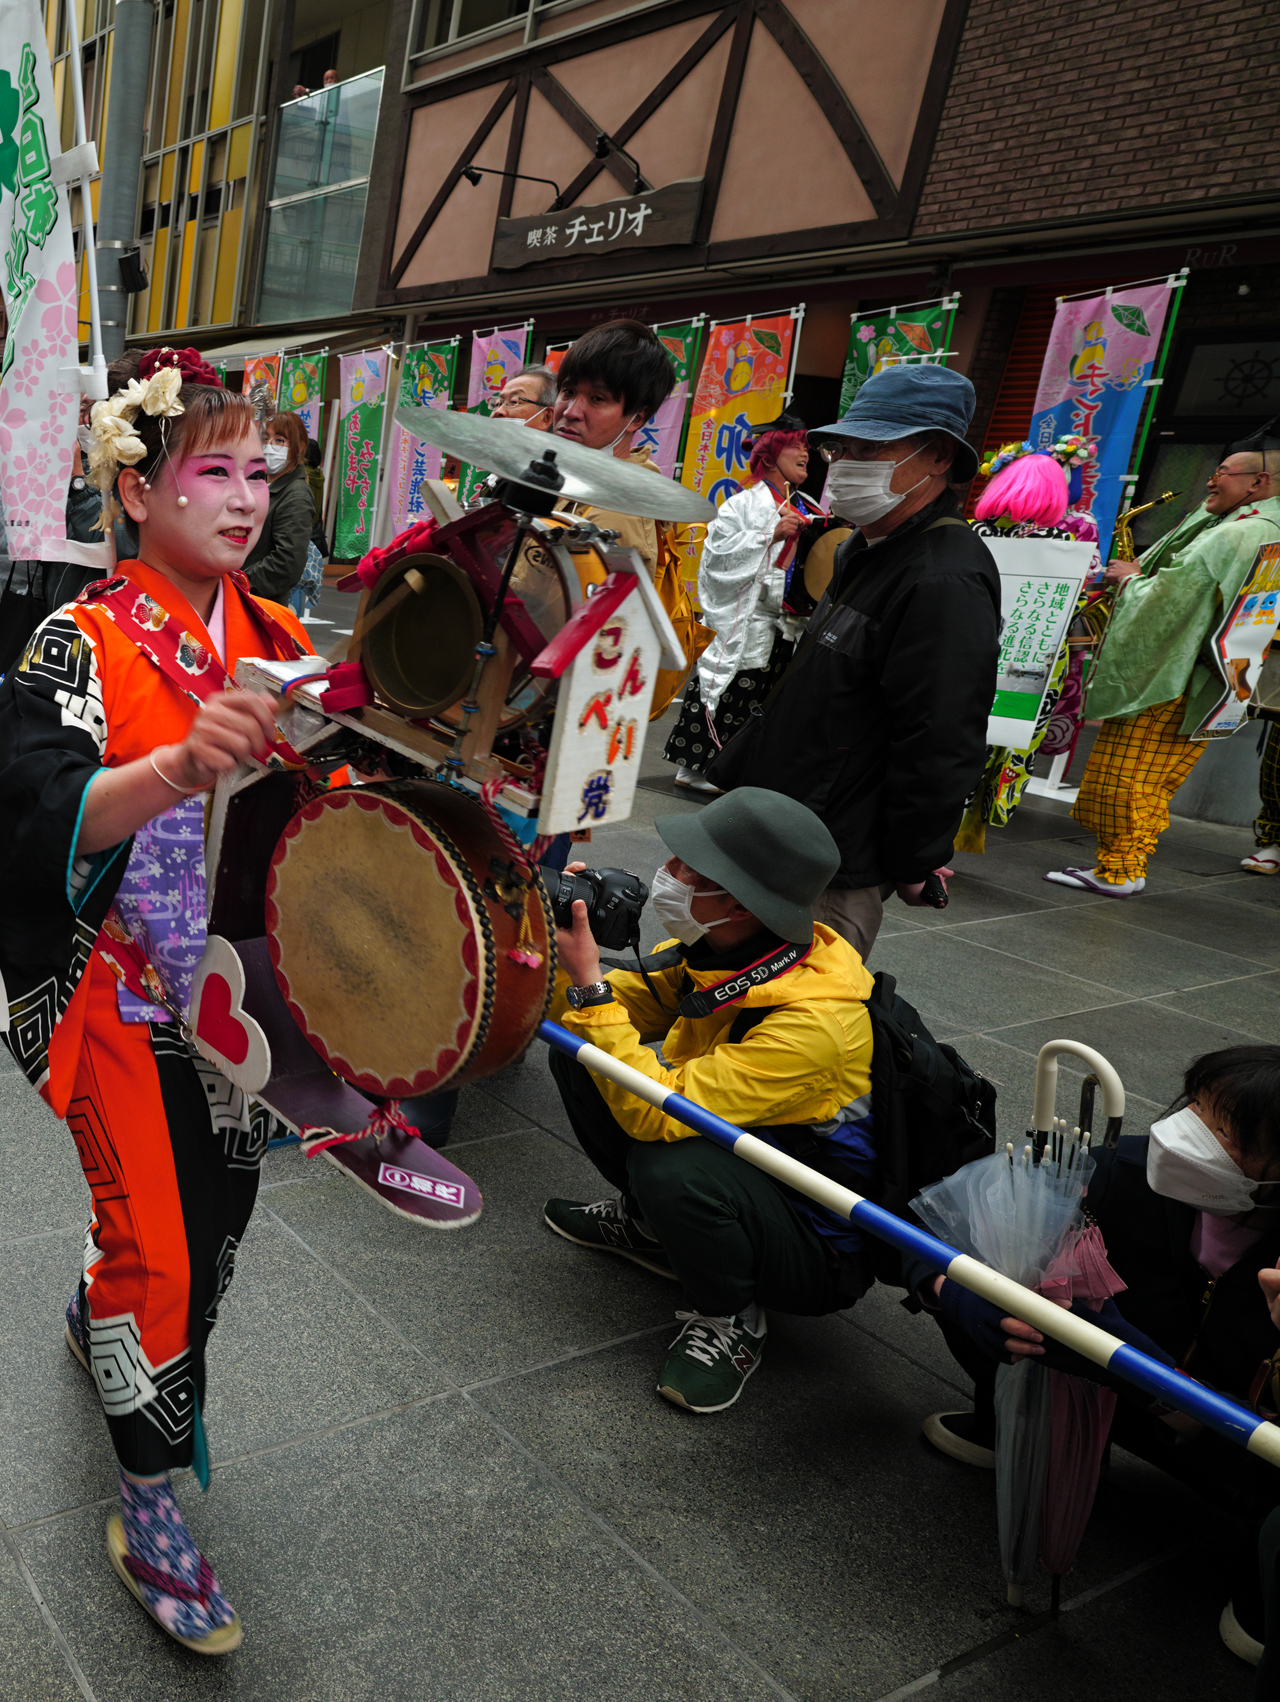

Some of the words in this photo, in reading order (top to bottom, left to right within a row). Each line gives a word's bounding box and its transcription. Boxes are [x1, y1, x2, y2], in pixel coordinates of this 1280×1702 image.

[526, 226, 559, 249] 喫茶
[564, 203, 653, 248] チェリオ
[1032, 582, 1071, 671] 地域とともに。
[714, 976, 751, 1001] EOS
[751, 966, 769, 983] 5D
[770, 956, 790, 973] Mark
[788, 950, 798, 961] IV
